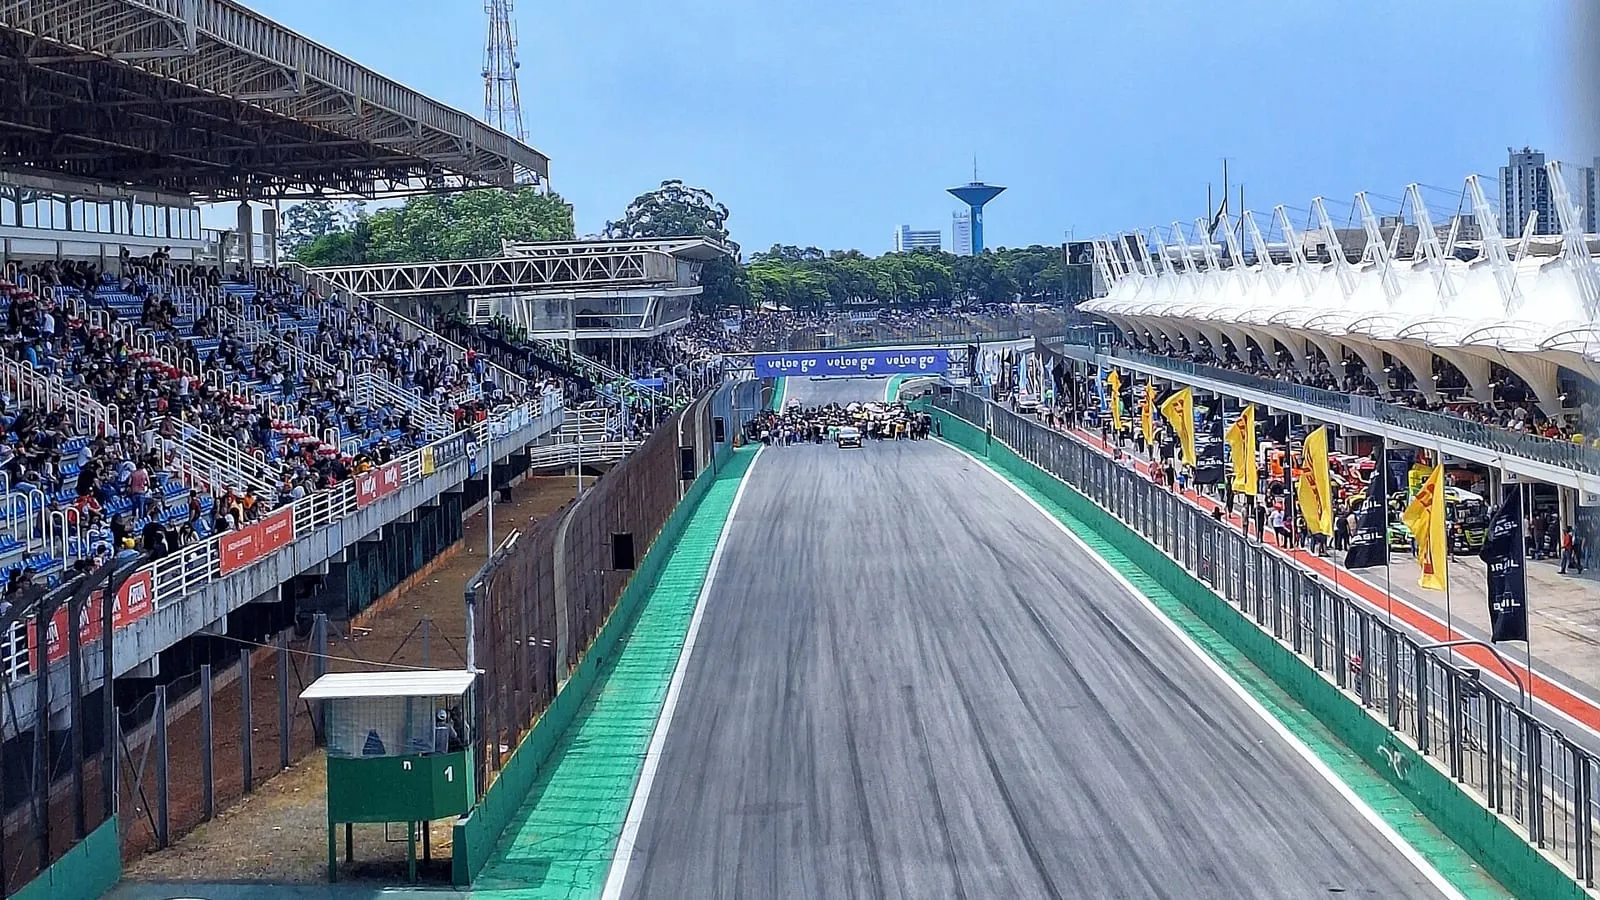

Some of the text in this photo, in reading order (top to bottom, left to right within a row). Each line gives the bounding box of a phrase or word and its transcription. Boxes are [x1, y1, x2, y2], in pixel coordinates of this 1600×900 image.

[767, 357, 817, 372] veloe go
[826, 356, 876, 371] veloe go
[885, 354, 935, 369] veloe go
[402, 760, 453, 782] n 1
